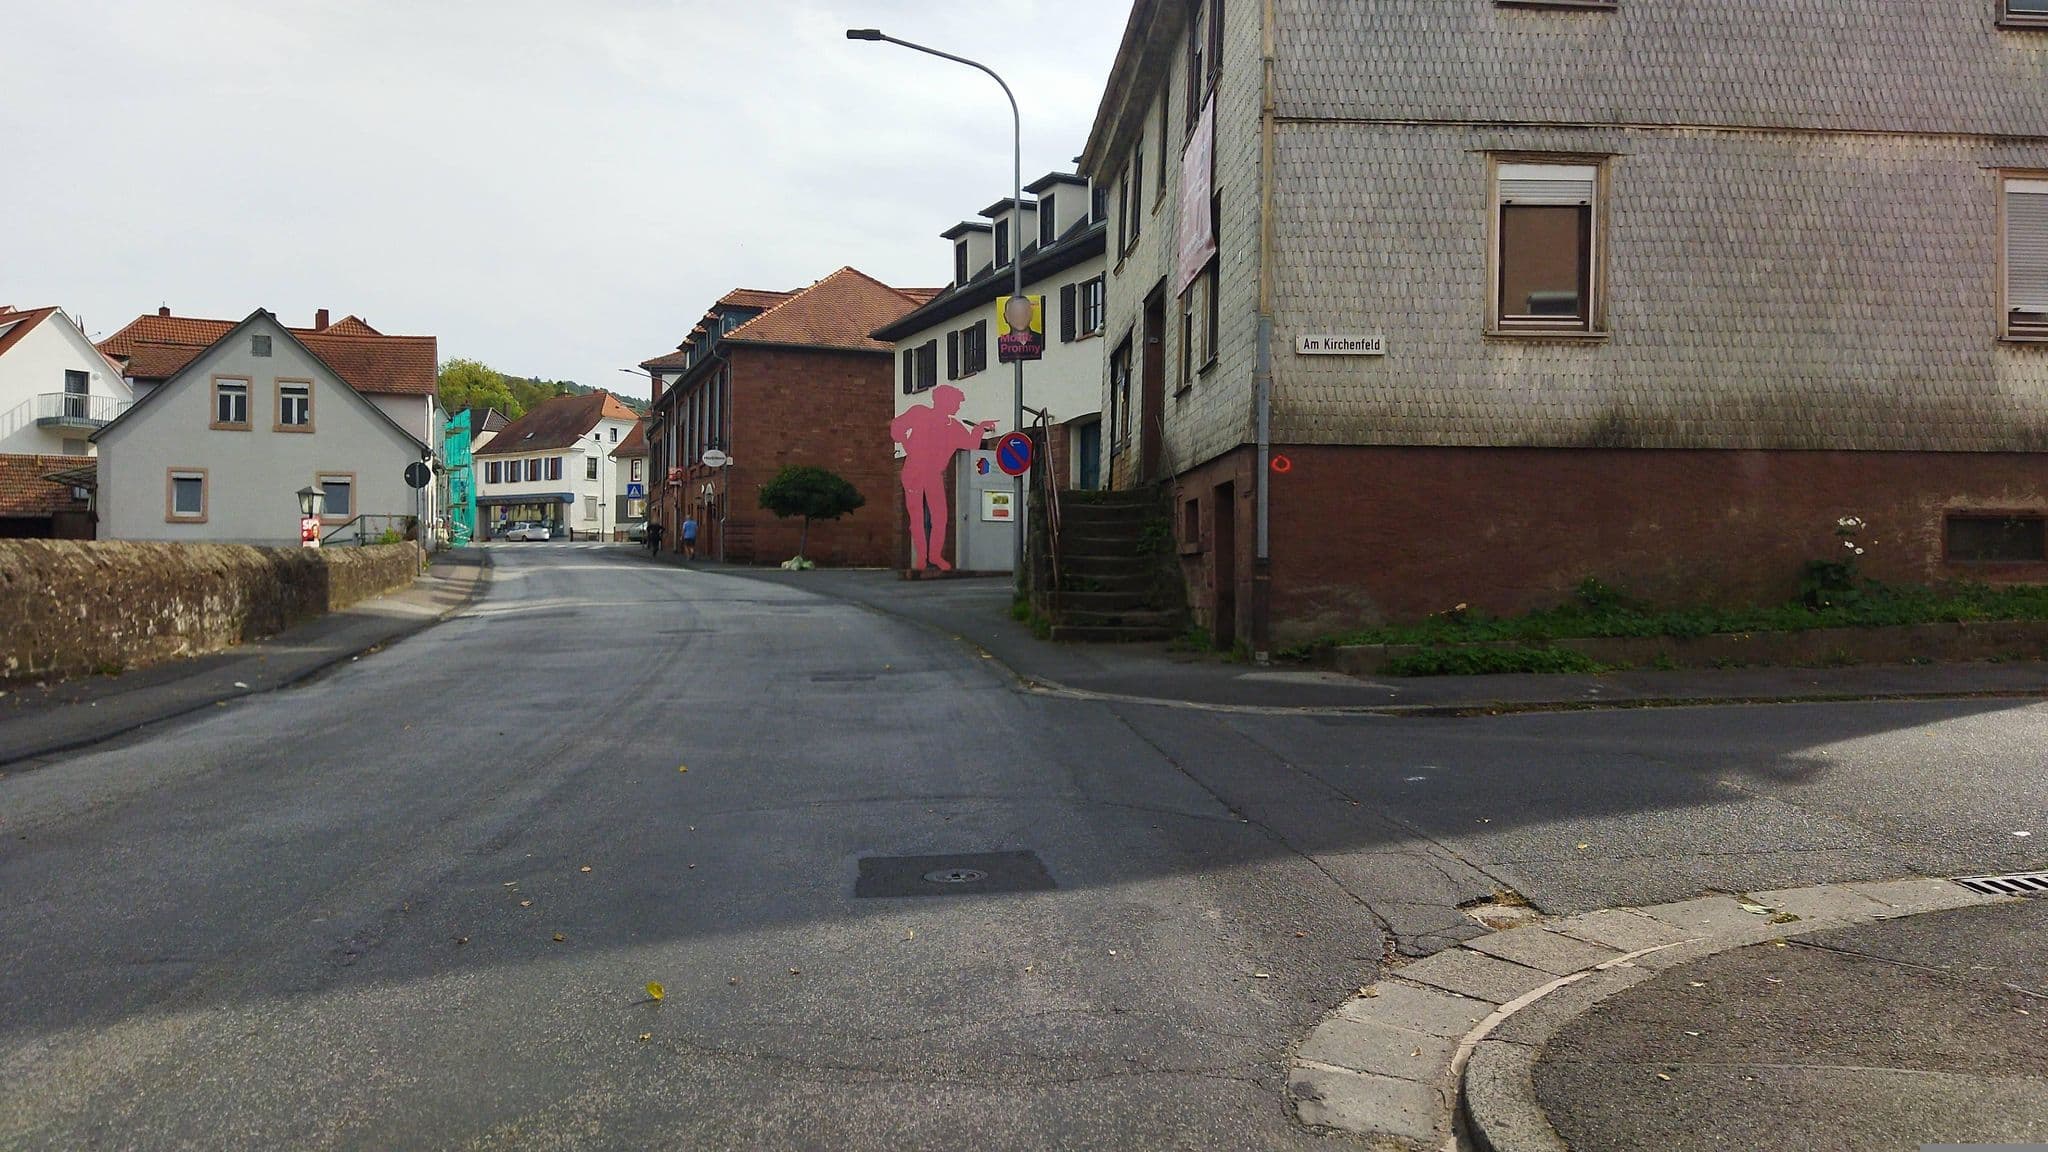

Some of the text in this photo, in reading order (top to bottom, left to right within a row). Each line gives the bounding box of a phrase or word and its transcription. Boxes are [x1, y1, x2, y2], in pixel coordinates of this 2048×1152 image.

[1001, 344, 1041, 354] Promny
[1303, 338, 1381, 351] Am Kirchenfeld
